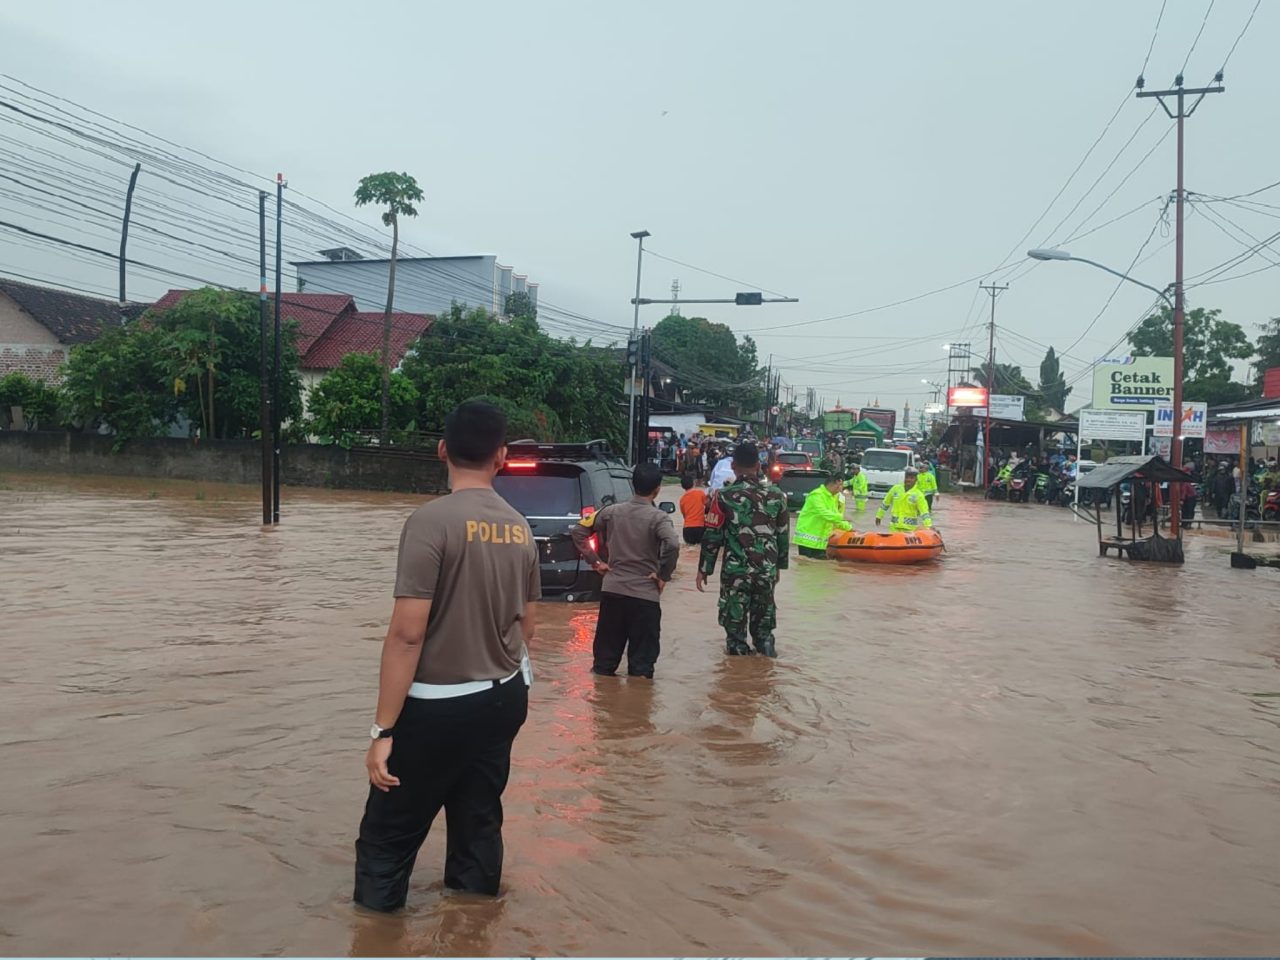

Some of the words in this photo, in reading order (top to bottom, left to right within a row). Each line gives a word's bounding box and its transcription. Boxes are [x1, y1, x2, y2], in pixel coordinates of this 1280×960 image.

[1110, 371, 1161, 384] Cetak
[1110, 383, 1174, 396] Banner
[466, 520, 529, 546] POLISI
